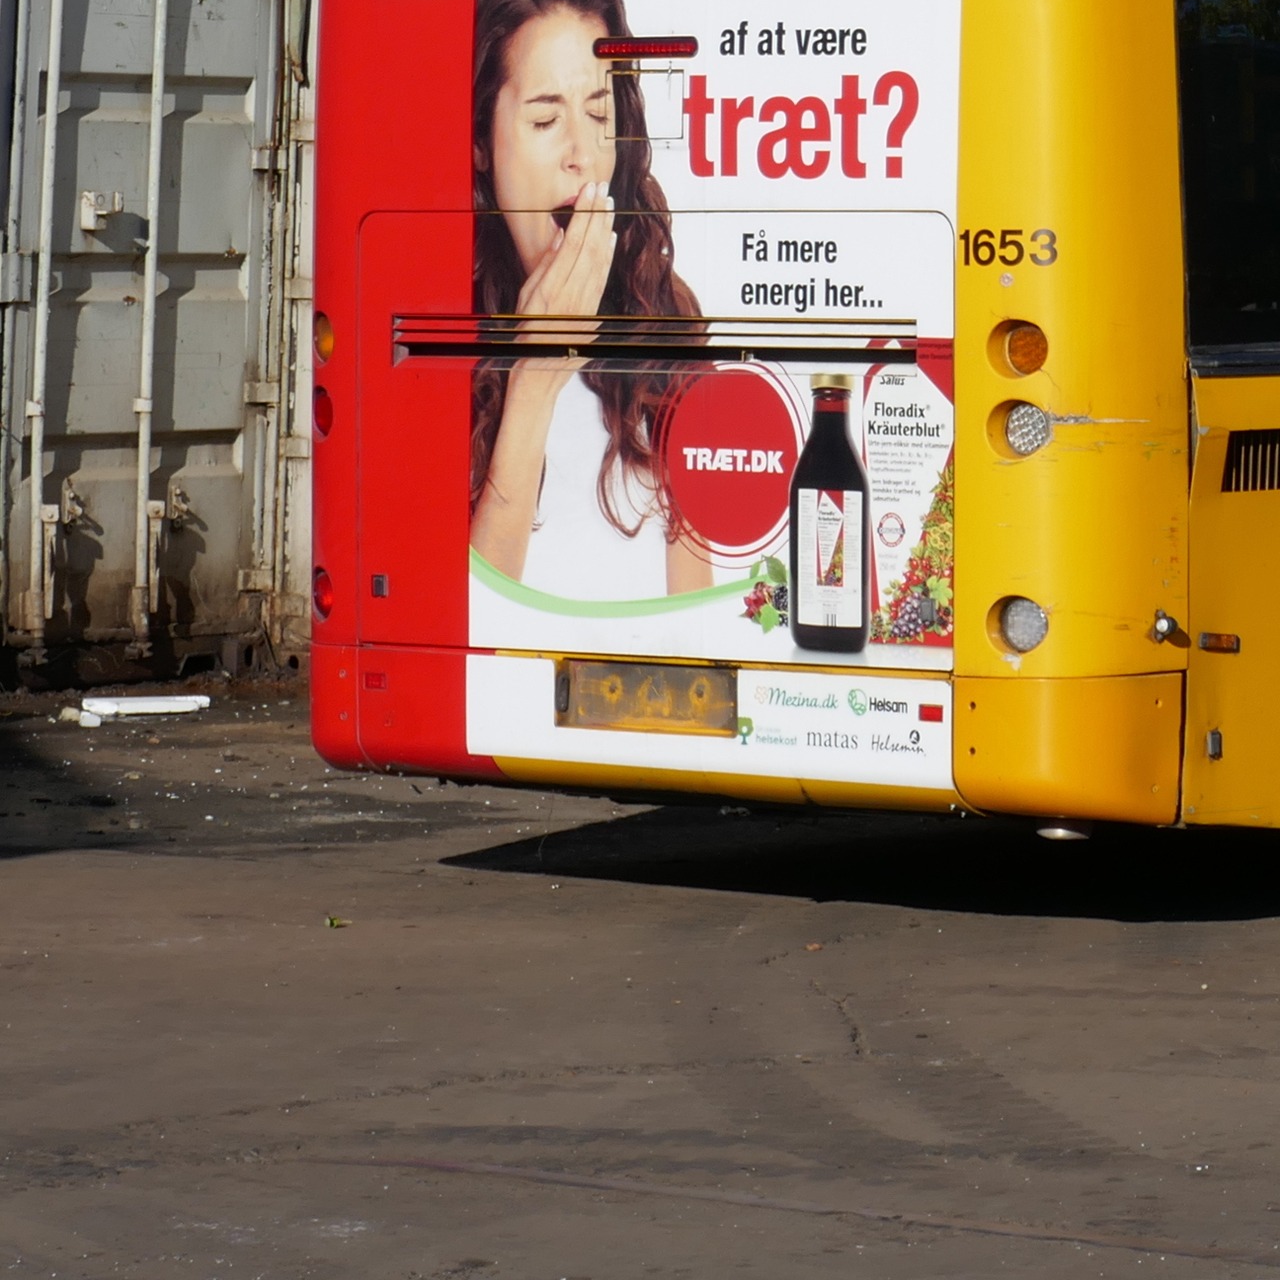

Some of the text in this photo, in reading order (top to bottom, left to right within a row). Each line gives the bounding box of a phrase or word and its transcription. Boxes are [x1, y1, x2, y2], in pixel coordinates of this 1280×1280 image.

[719, 21, 867, 56] af at være
[683, 70, 919, 179] træt?
[741, 230, 838, 263] Få mere
[959, 229, 1058, 267] 1653
[741, 278, 884, 312] energi her...
[683, 448, 784, 473] TRÆT.DK
[768, 687, 839, 710] Mezina.dk
[869, 697, 908, 714] Helsam
[755, 733, 798, 746] helsekost
[806, 731, 858, 749] matas
